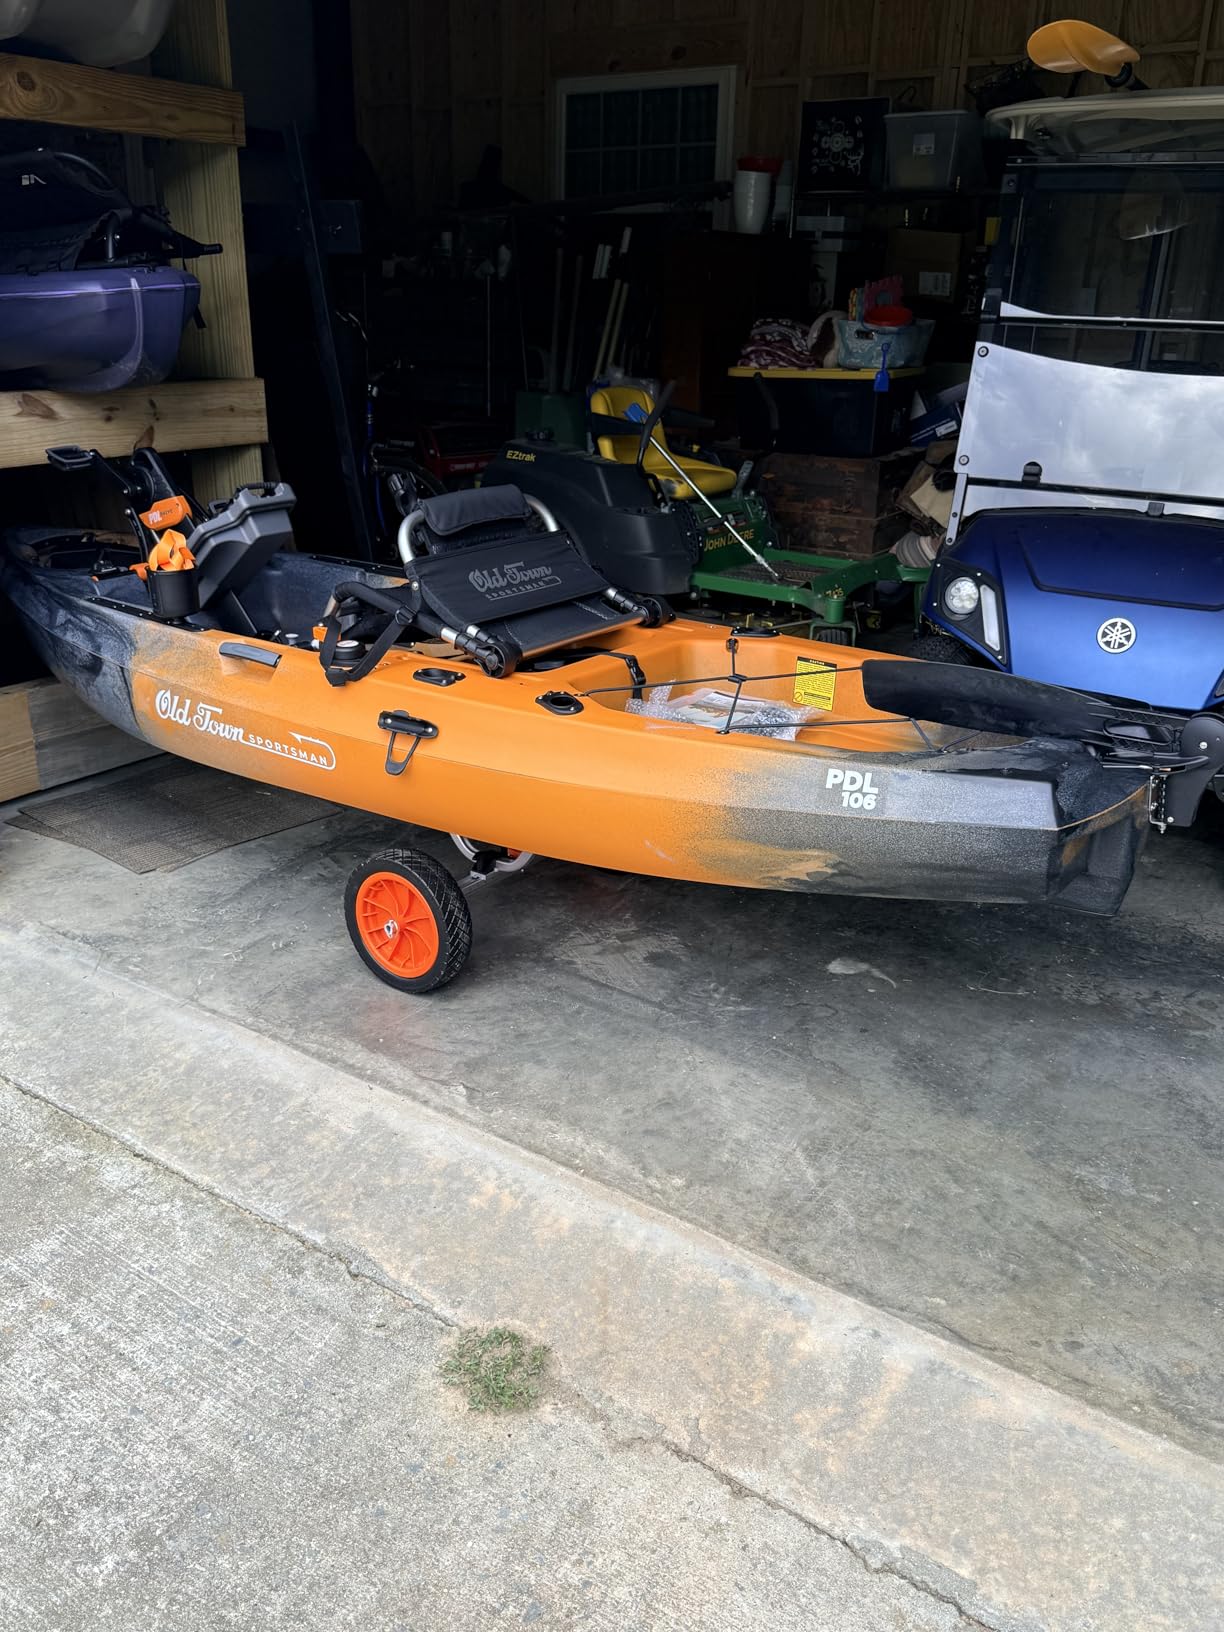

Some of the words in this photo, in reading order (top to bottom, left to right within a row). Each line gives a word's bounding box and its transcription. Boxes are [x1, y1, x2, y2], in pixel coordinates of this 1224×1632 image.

[506, 449, 536, 462] EZtrak
[703, 536, 727, 552] JOHN
[468, 568, 508, 593] Old
[503, 561, 552, 585] Town
[484, 580, 547, 599] SPORTSMAN
[155, 688, 192, 726] Old
[192, 701, 246, 745] Town
[248, 733, 328, 766] SPORTSMAN
[825, 768, 879, 795] PDL
[841, 791, 877, 811] 106
